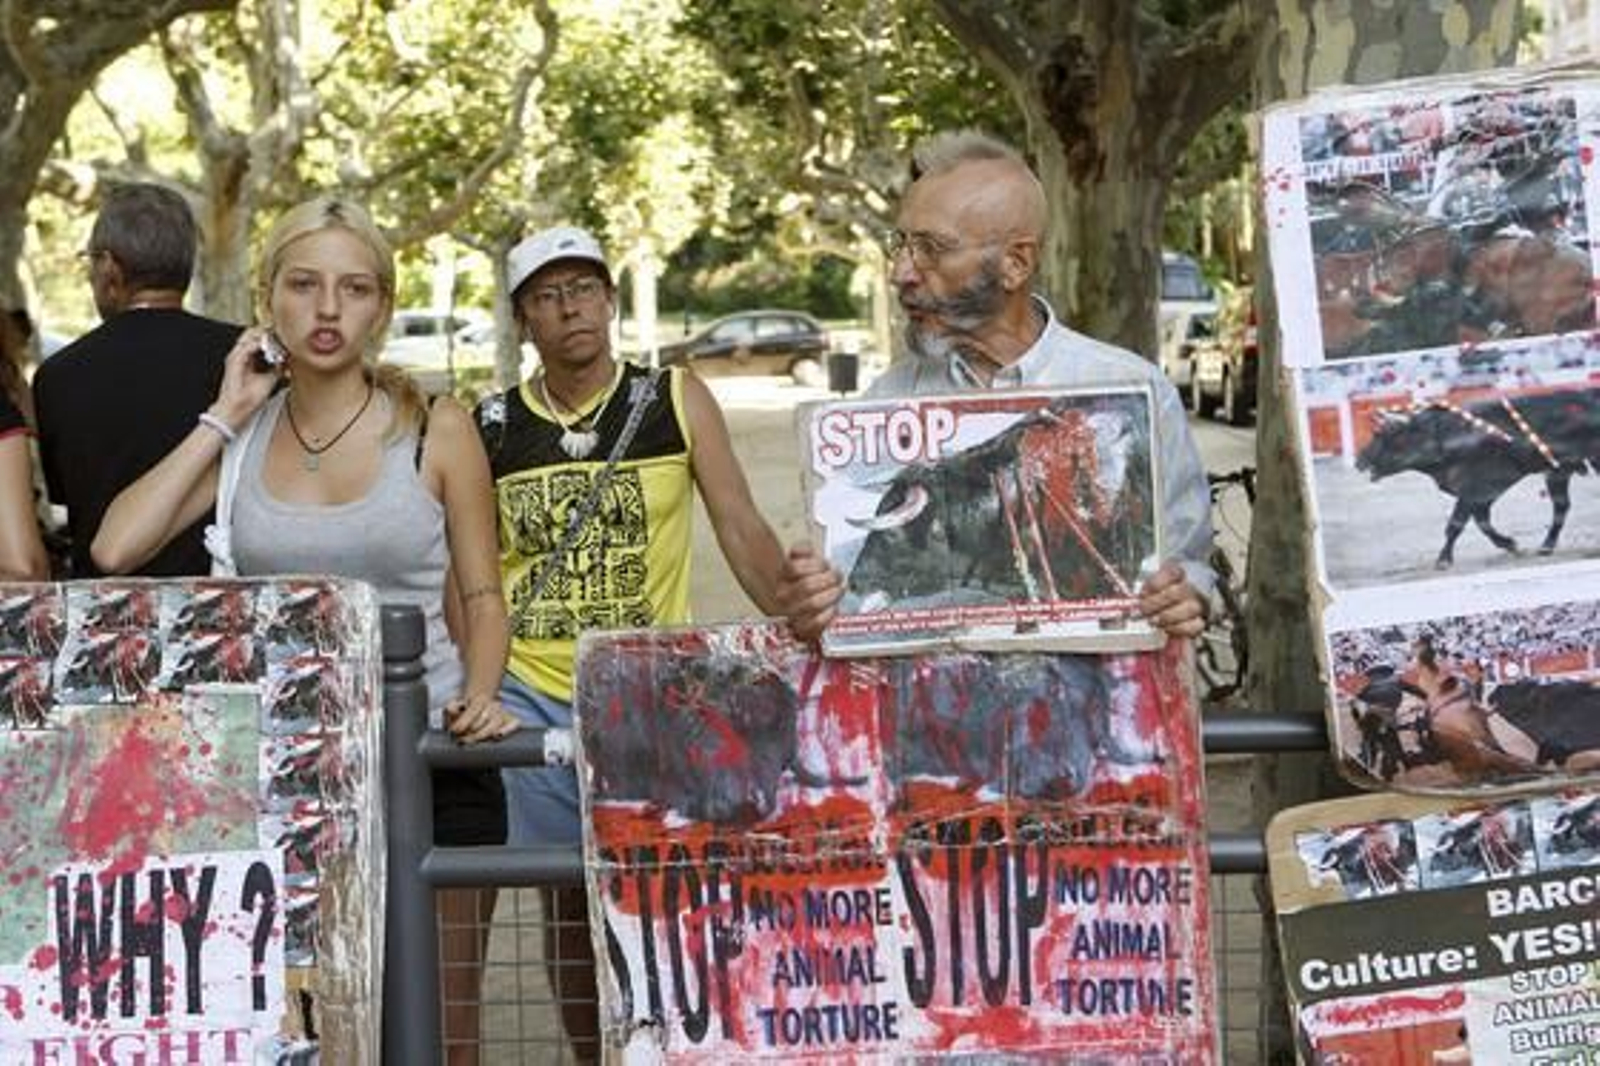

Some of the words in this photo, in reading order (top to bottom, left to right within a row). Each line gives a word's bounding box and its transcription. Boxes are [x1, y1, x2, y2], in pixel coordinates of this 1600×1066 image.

[819, 407, 956, 468] STOP
[1055, 862, 1100, 905] NO
[1108, 864, 1192, 906] MORE
[1486, 874, 1600, 918] BARC
[750, 886, 796, 932] NO
[803, 886, 893, 929] MORE
[896, 817, 1050, 1009] STOP
[54, 866, 218, 1021] WHY
[1070, 918, 1183, 961] ANIMAL
[772, 945, 887, 989] ANIMAL
[1300, 945, 1479, 992] Culture:
[1510, 960, 1587, 995] STOP
[756, 1001, 900, 1047] TORTURE
[1492, 986, 1600, 1028] ANIMAL
